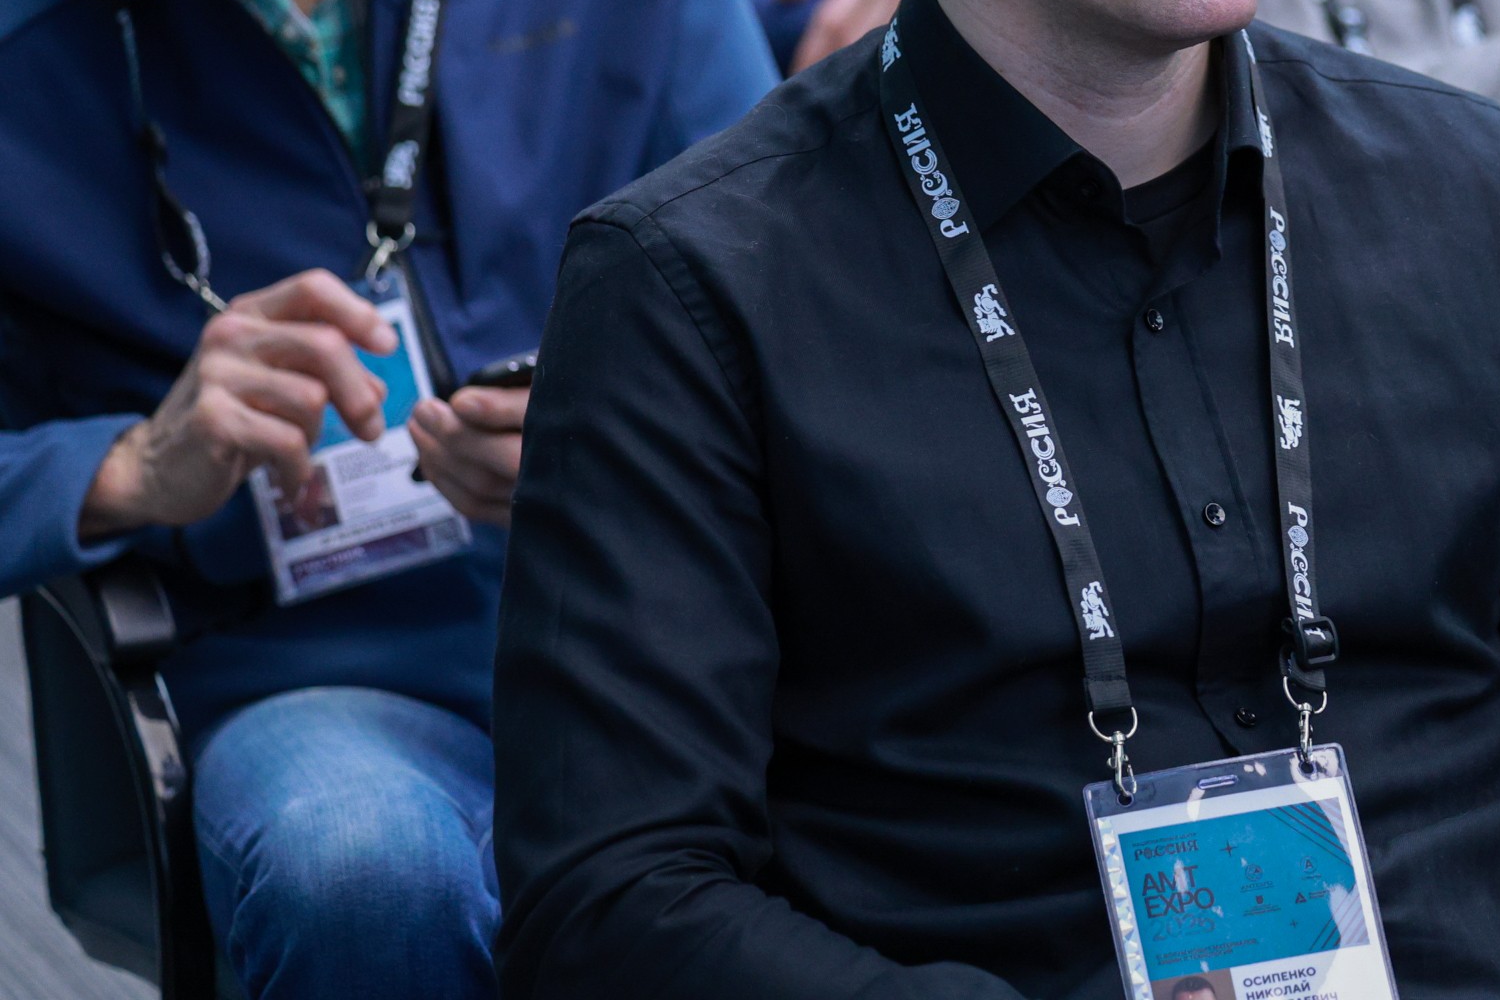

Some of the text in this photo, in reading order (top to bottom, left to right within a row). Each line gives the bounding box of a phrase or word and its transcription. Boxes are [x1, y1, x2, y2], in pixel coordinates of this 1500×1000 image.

[894, 102, 969, 239] РОССИЯ
[1269, 206, 1295, 349] РОССИЯ
[1009, 387, 1081, 527] РОССИЯ
[1134, 839, 1199, 861] РОССИЯ
[1142, 865, 1198, 896] AMT
[1144, 887, 1215, 919] EXPO
[1243, 966, 1317, 988] ОСИПЕНКО
[1246, 979, 1311, 1000] НИКОЛАЙ
